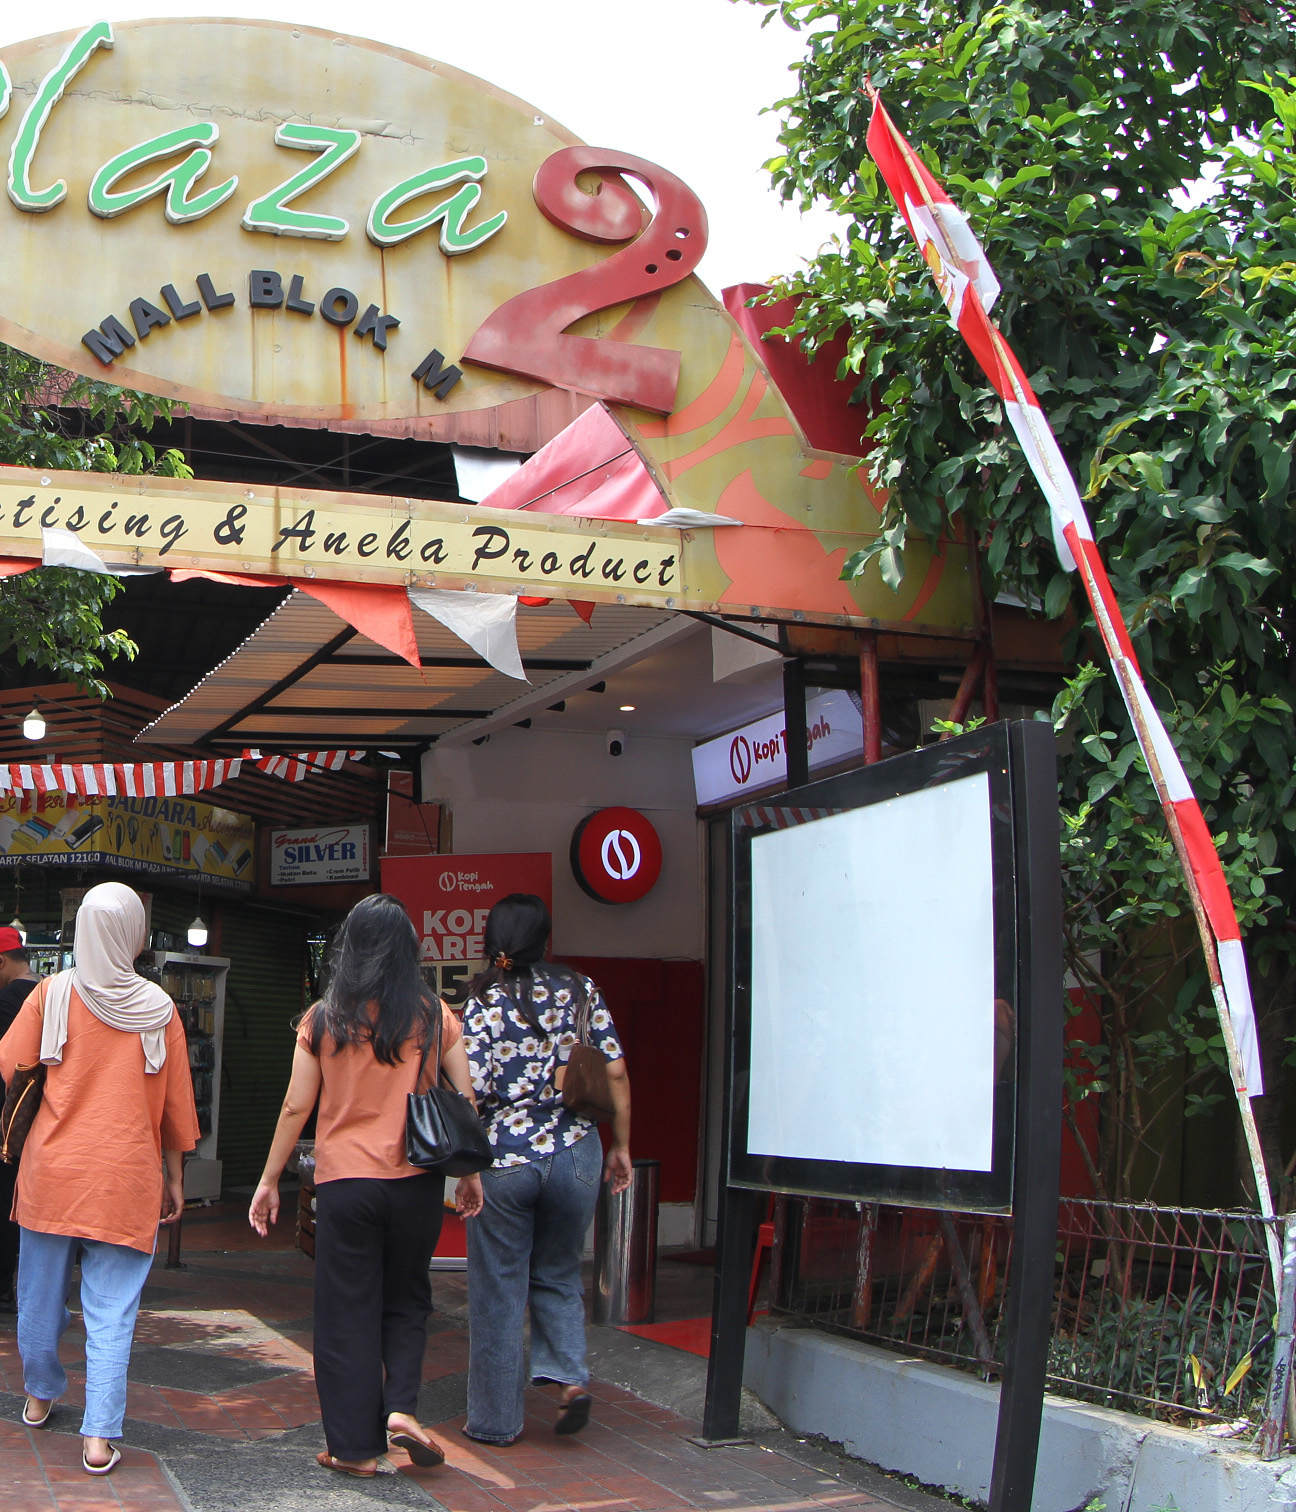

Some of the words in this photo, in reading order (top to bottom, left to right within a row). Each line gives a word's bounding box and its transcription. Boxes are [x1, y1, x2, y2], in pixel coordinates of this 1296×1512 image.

[460, 146, 709, 417] 2
[81, 273, 236, 365] MALL
[249, 268, 400, 351] BLOK
[411, 347, 464, 400] M
[213, 503, 248, 547] &
[272, 509, 449, 567] Aneka
[470, 525, 678, 588] Product
[274, 833, 319, 849] Grand
[284, 842, 356, 865] SILVER
[457, 871, 478, 882] Kopi
[457, 881, 493, 893] Tengah
[423, 909, 491, 935] KOP
